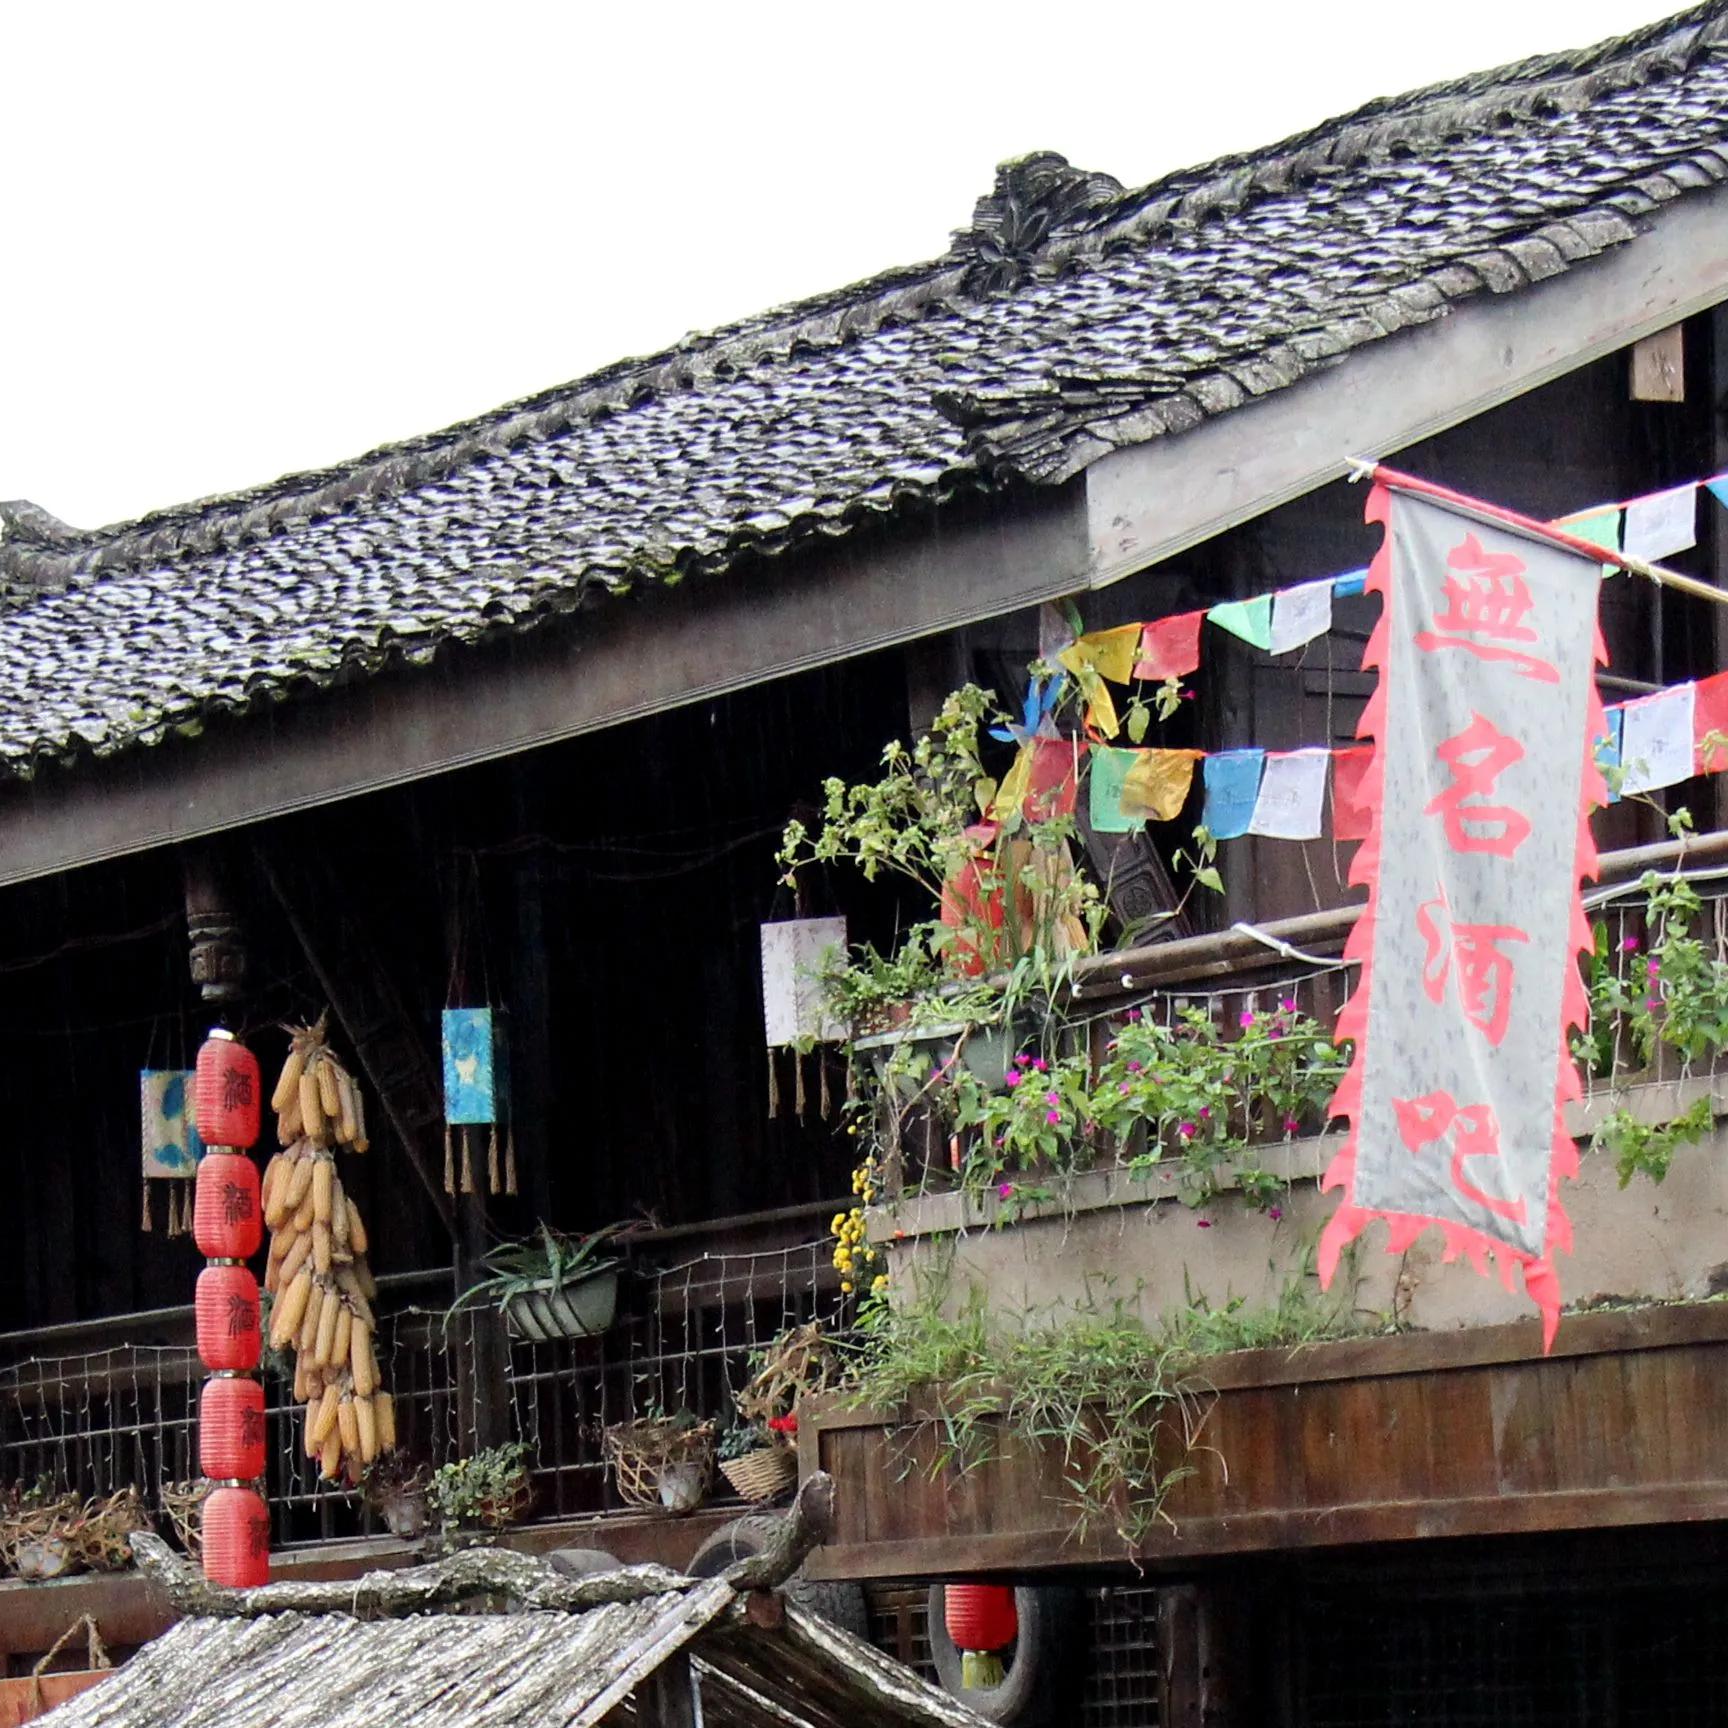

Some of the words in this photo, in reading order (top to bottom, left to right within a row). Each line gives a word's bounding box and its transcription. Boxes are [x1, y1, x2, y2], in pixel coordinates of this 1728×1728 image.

[1391, 532, 1562, 1226] 無名酒吧
[222, 1064, 253, 1113] 酒
[222, 1182, 254, 1227] 酒
